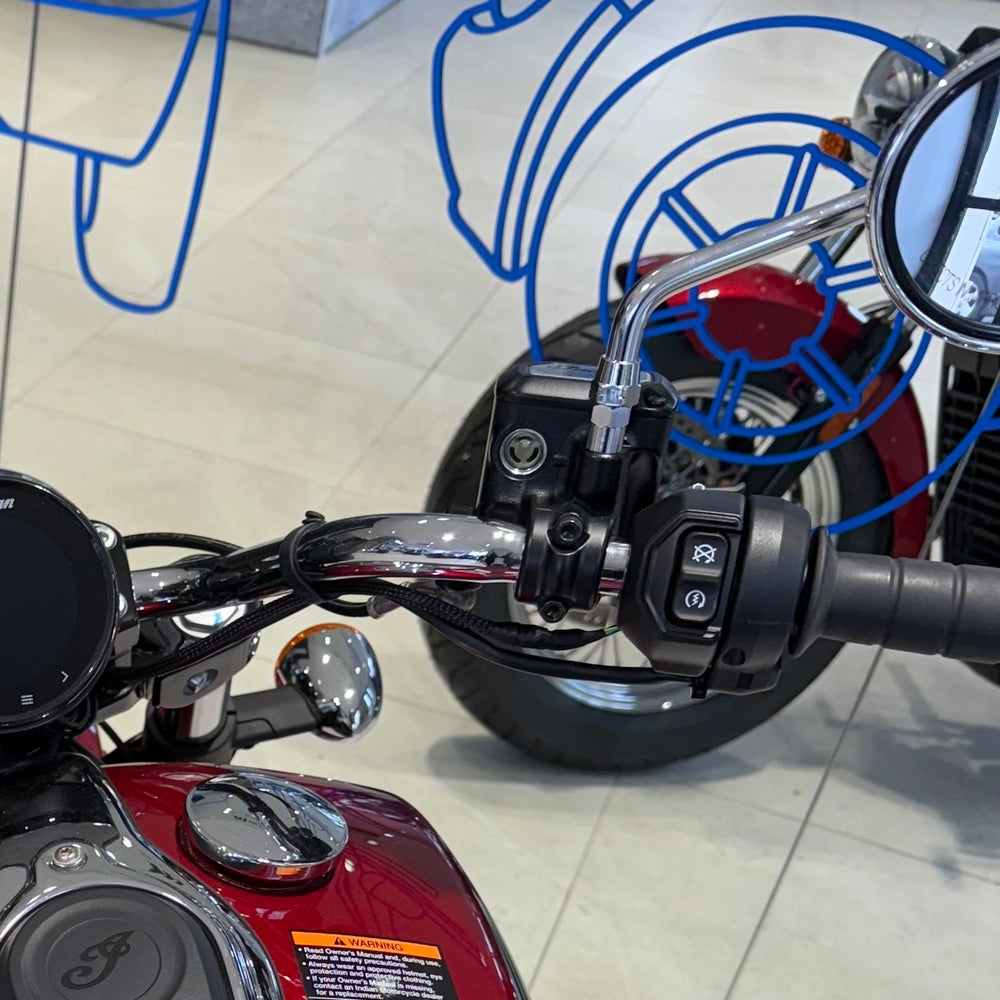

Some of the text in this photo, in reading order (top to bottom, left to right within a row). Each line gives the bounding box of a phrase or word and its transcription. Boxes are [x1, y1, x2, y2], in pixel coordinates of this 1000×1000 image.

[348, 938, 403, 951] WARNING
[325, 948, 356, 957] Owner's
[356, 950, 384, 960] Manual
[402, 956, 425, 965] during
[340, 956, 362, 964] safety
[364, 958, 408, 969] precautions.
[308, 961, 335, 969] Always
[366, 966, 401, 975] approved
[429, 973, 443, 981] eye
[309, 968, 348, 976] protection
[365, 971, 401, 981] protective
[337, 976, 368, 985] Owner's
[397, 981, 404, 989] is
[335, 990, 384, 1000] replacement.
[354, 984, 379, 993] Indian
[421, 992, 443, 1000] dealer
